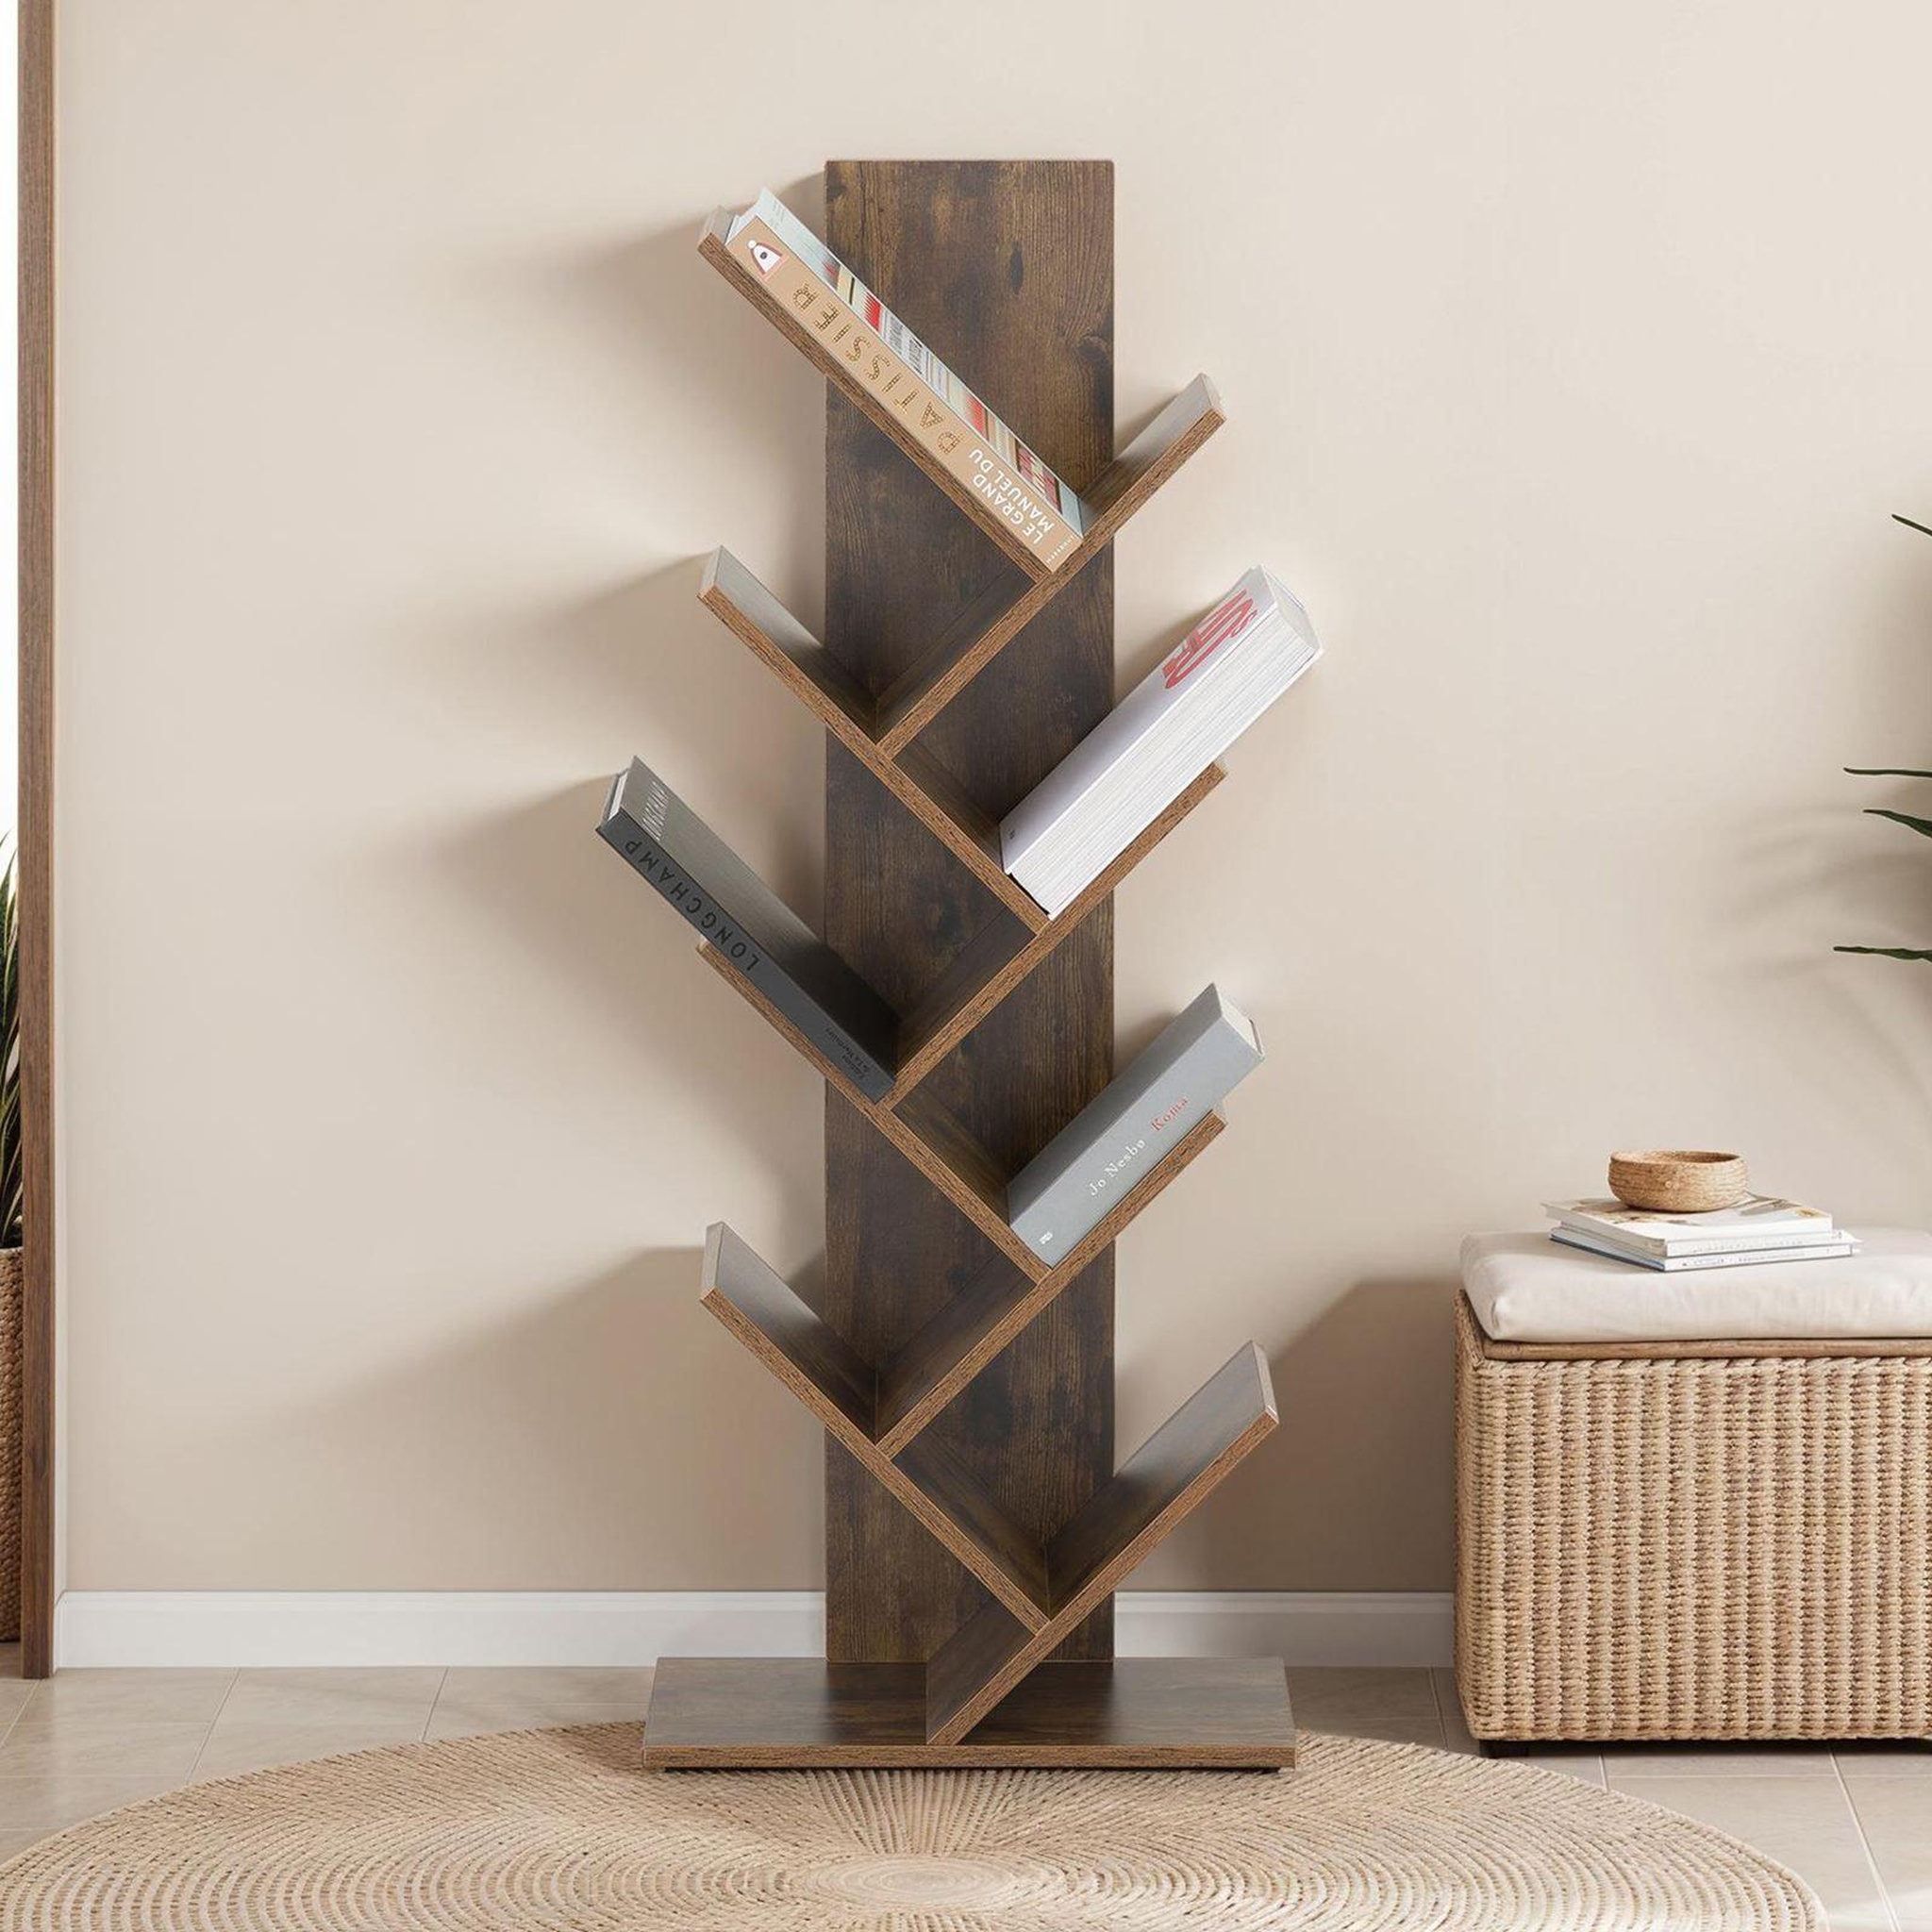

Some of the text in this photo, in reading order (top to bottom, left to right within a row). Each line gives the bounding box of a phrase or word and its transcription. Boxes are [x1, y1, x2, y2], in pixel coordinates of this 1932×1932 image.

[968, 448, 1056, 532] MANUEL DU
[973, 474, 1043, 544] LE GRAND
[625, 840, 762, 972] LONGCHAMP
[1150, 1098, 1189, 1131] Koma
[1088, 1178, 1107, 1196] Jo
